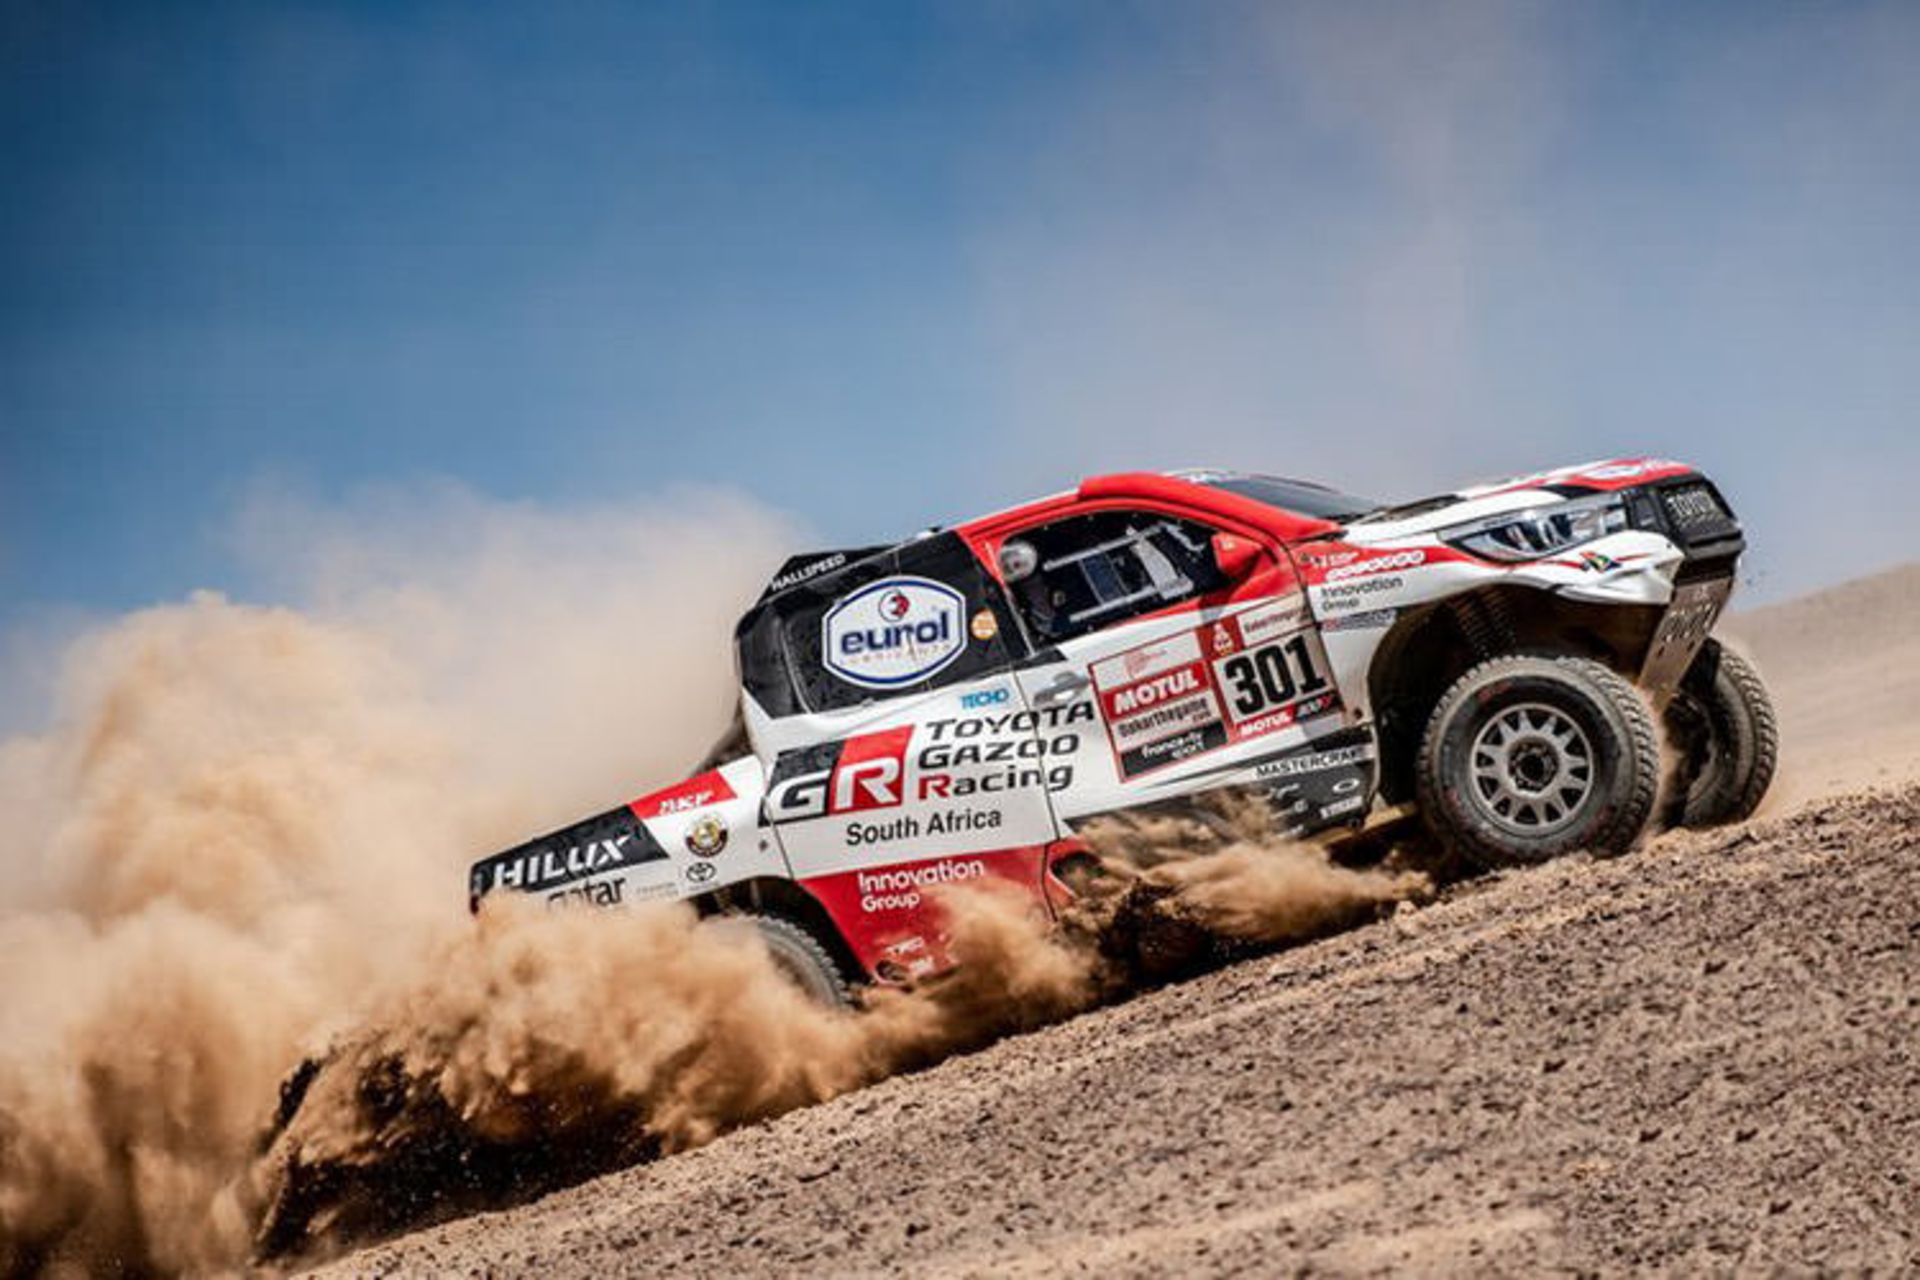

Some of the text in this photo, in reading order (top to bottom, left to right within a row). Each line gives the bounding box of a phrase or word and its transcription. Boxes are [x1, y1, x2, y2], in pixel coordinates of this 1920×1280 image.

[1320, 577, 1404, 597] Innovation
[841, 610, 949, 655] eurol
[1114, 669, 1200, 714] MOTUL
[1224, 634, 1326, 716] 301
[924, 700, 1095, 741] TOYOTA
[1238, 710, 1294, 736] MOTUL
[918, 733, 1080, 771] GAZOO
[768, 756, 901, 818] GR
[918, 764, 1074, 802] Racing
[846, 808, 1001, 846] South Africa
[494, 836, 632, 887] HILUX
[858, 858, 985, 896] Innovation
[862, 890, 920, 913] Group
